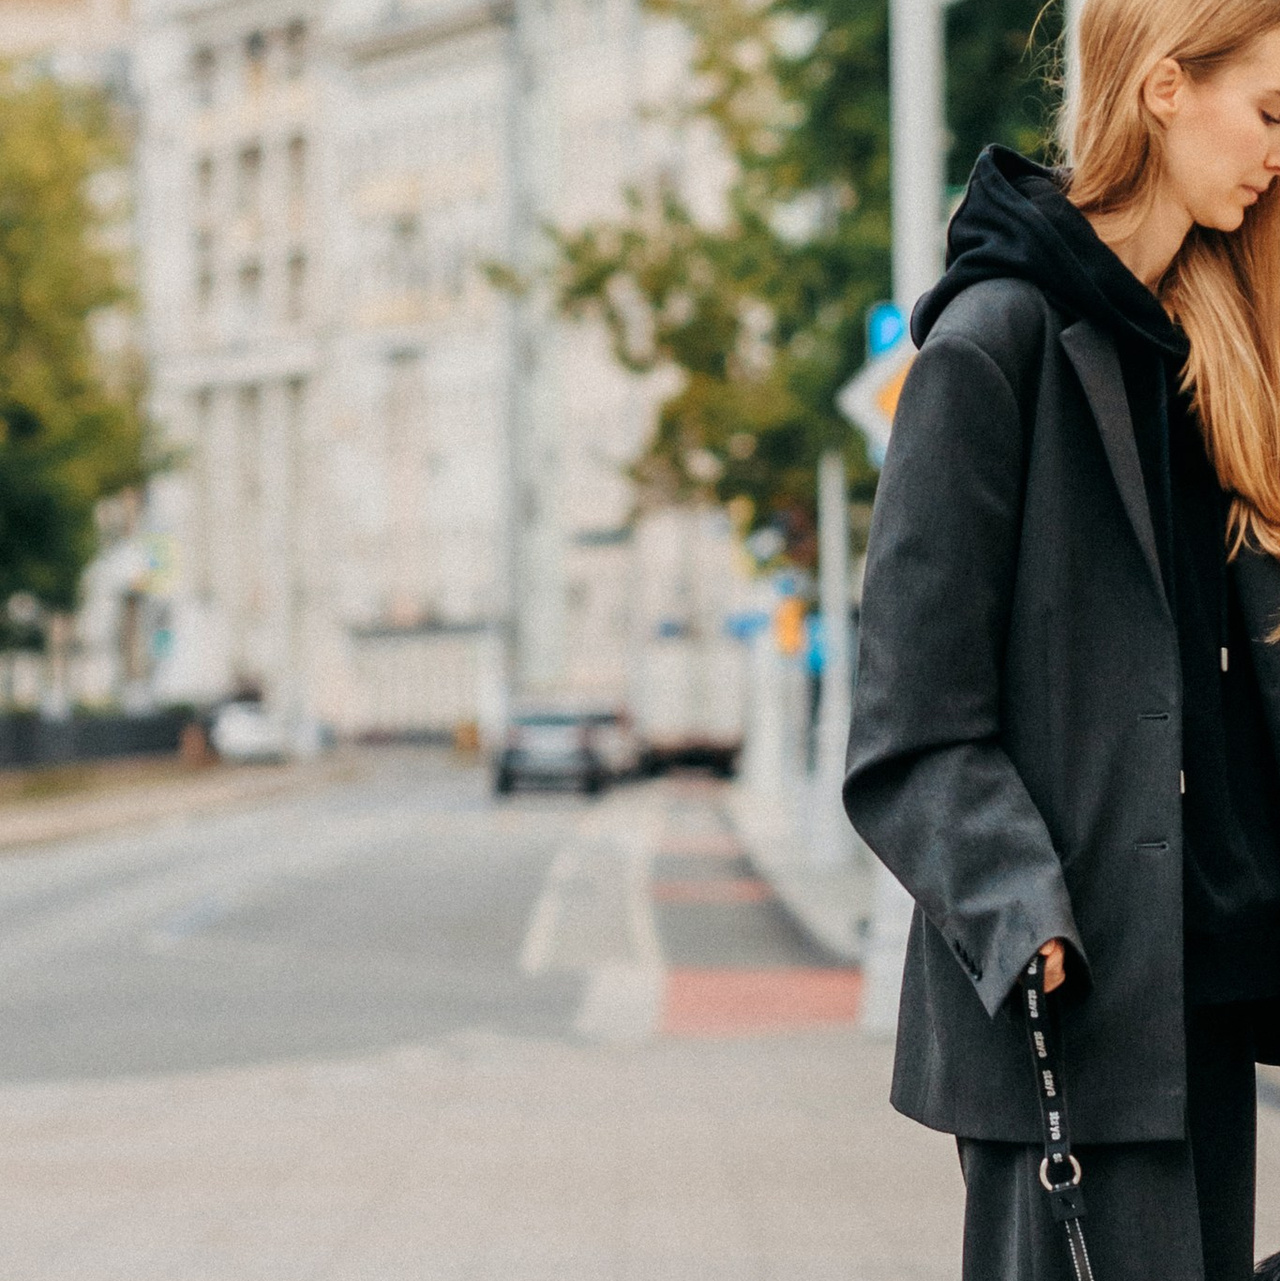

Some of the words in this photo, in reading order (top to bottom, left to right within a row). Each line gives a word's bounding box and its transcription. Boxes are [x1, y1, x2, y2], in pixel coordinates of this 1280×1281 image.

[1027, 989, 1039, 1018] staya
[1033, 1031, 1048, 1058] staya
[1042, 1070, 1056, 1097] staya
